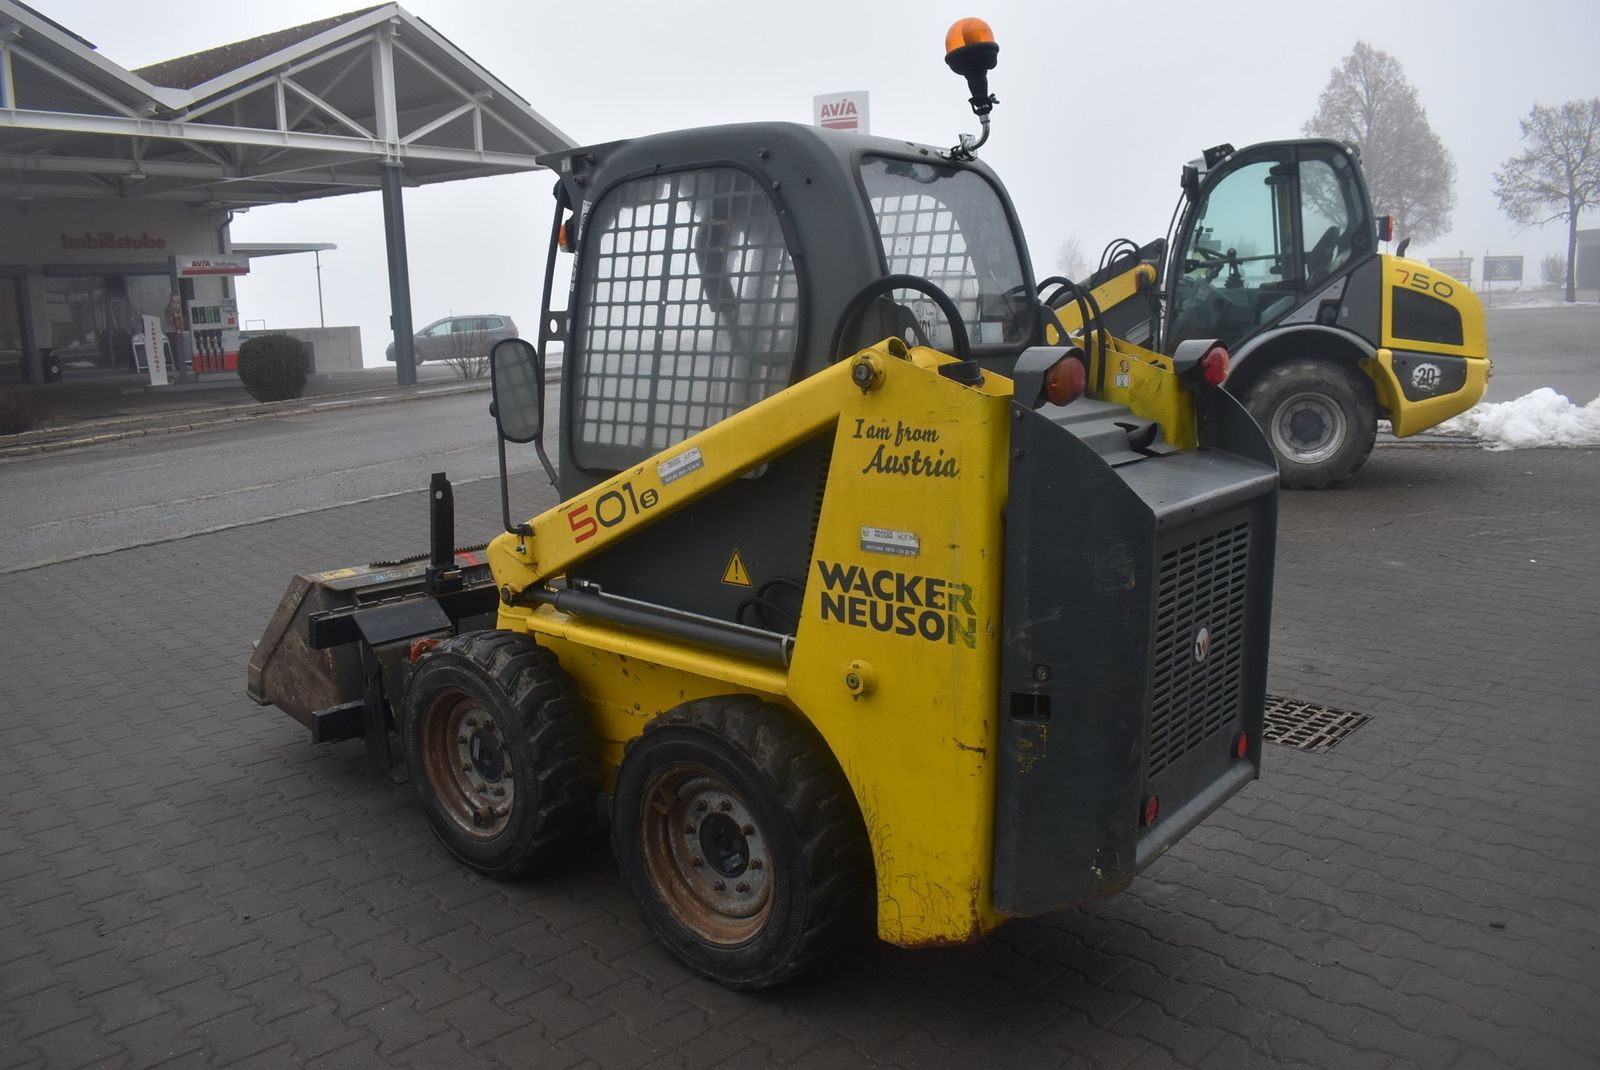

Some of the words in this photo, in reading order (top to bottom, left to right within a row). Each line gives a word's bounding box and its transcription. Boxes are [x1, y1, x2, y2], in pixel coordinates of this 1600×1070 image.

[820, 98, 858, 118] AVIA
[62, 232, 166, 250] Imbißstube
[191, 258, 211, 268] AVIA
[1395, 268, 1454, 298] 750
[1417, 367, 1435, 386] 20
[852, 418, 865, 439] I
[866, 424, 892, 441] am
[894, 420, 940, 447] from
[862, 444, 961, 478] Austria
[817, 560, 976, 616] WACKER
[820, 592, 977, 650] NEUSON
